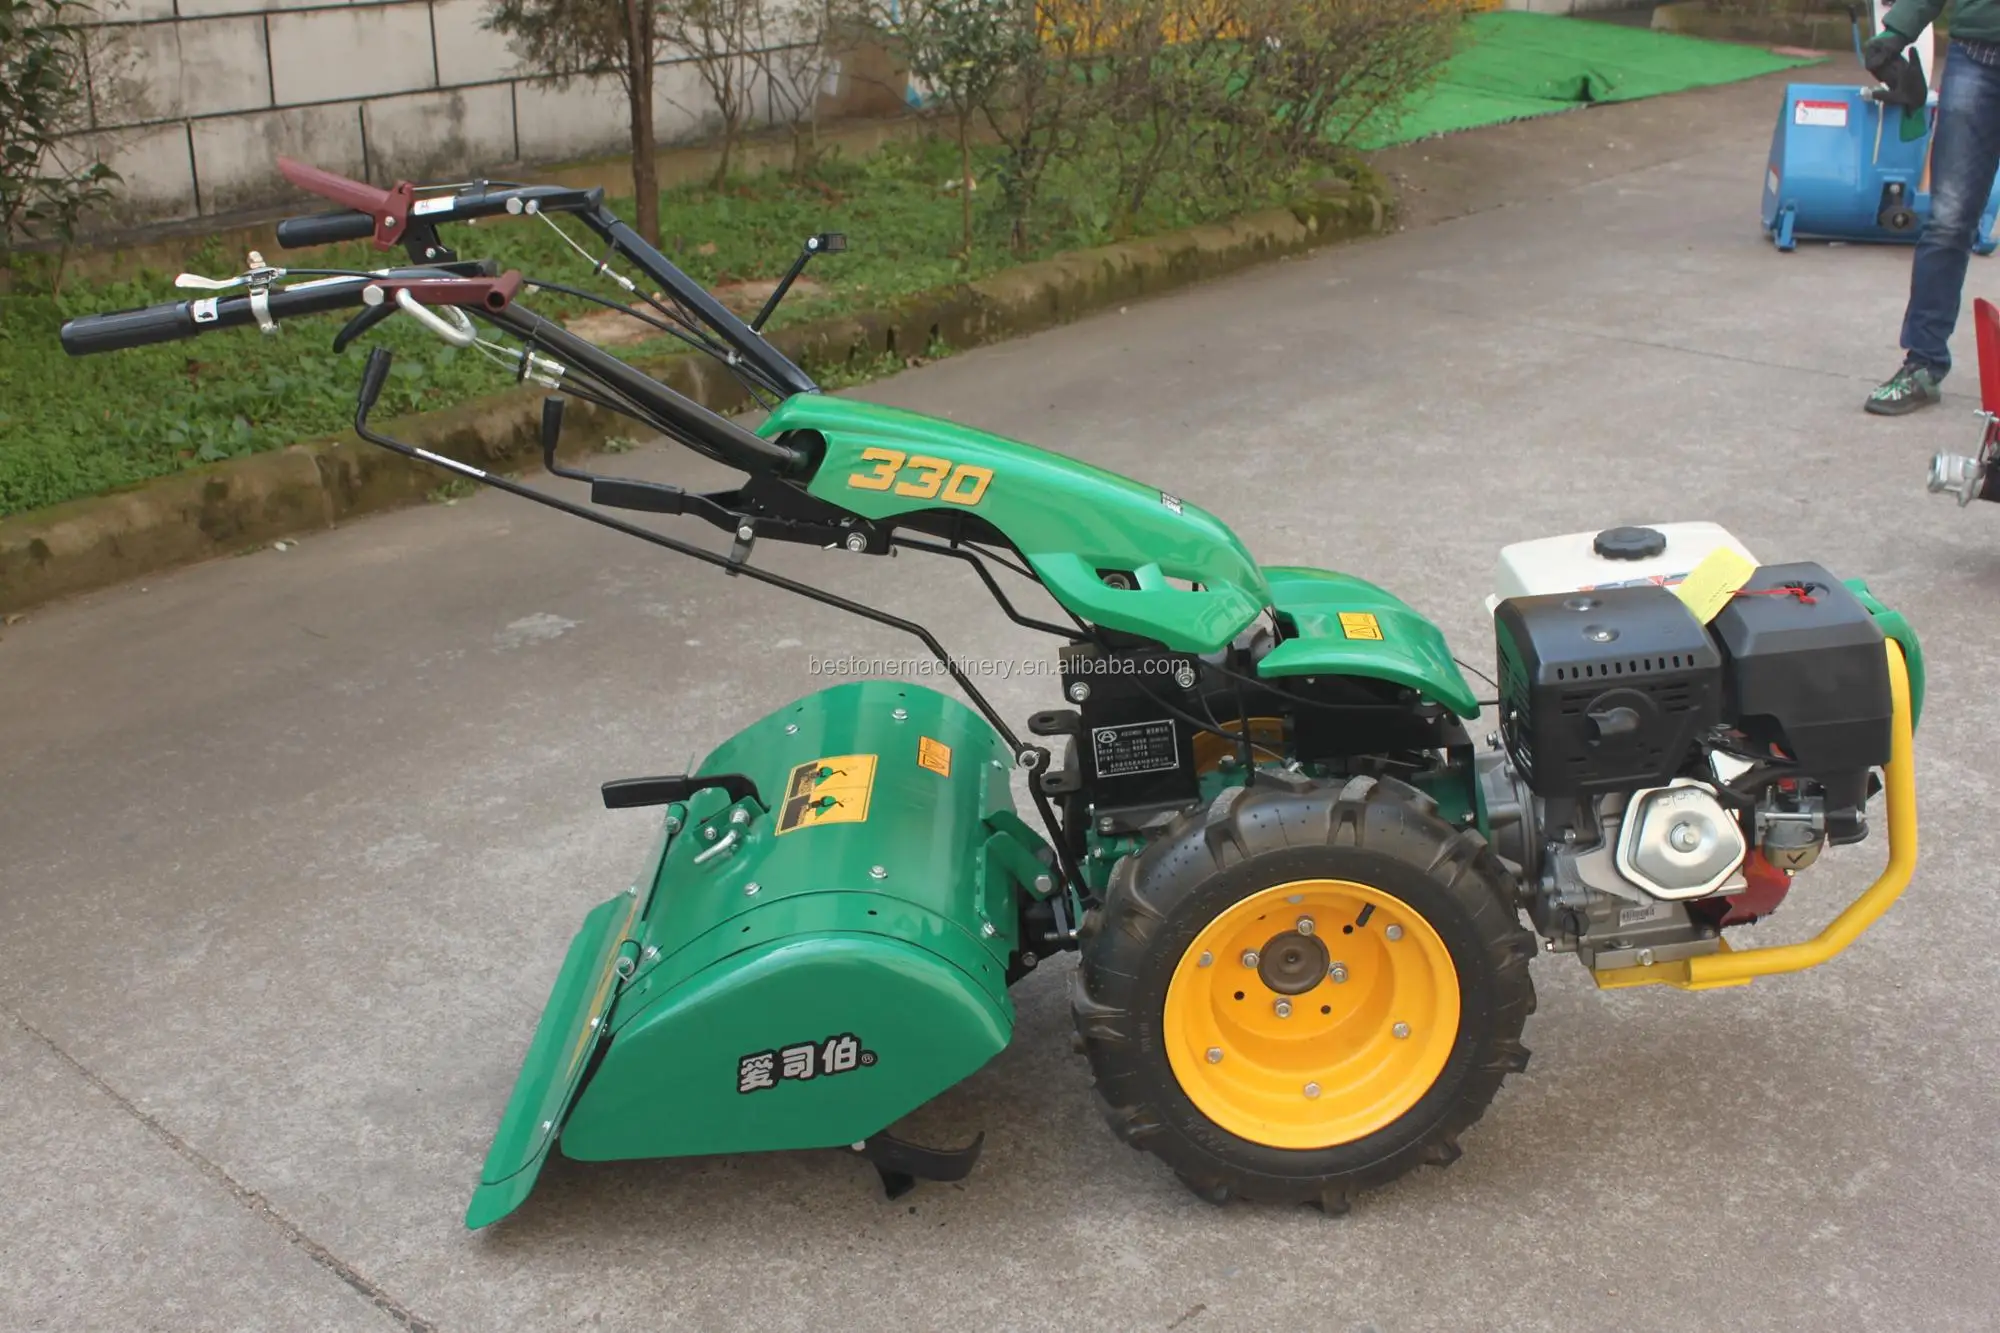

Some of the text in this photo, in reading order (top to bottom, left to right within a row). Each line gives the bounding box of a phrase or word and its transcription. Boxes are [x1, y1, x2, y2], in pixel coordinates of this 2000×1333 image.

[848, 447, 994, 506] 330
[740, 1036, 858, 1092] 爱司伯
